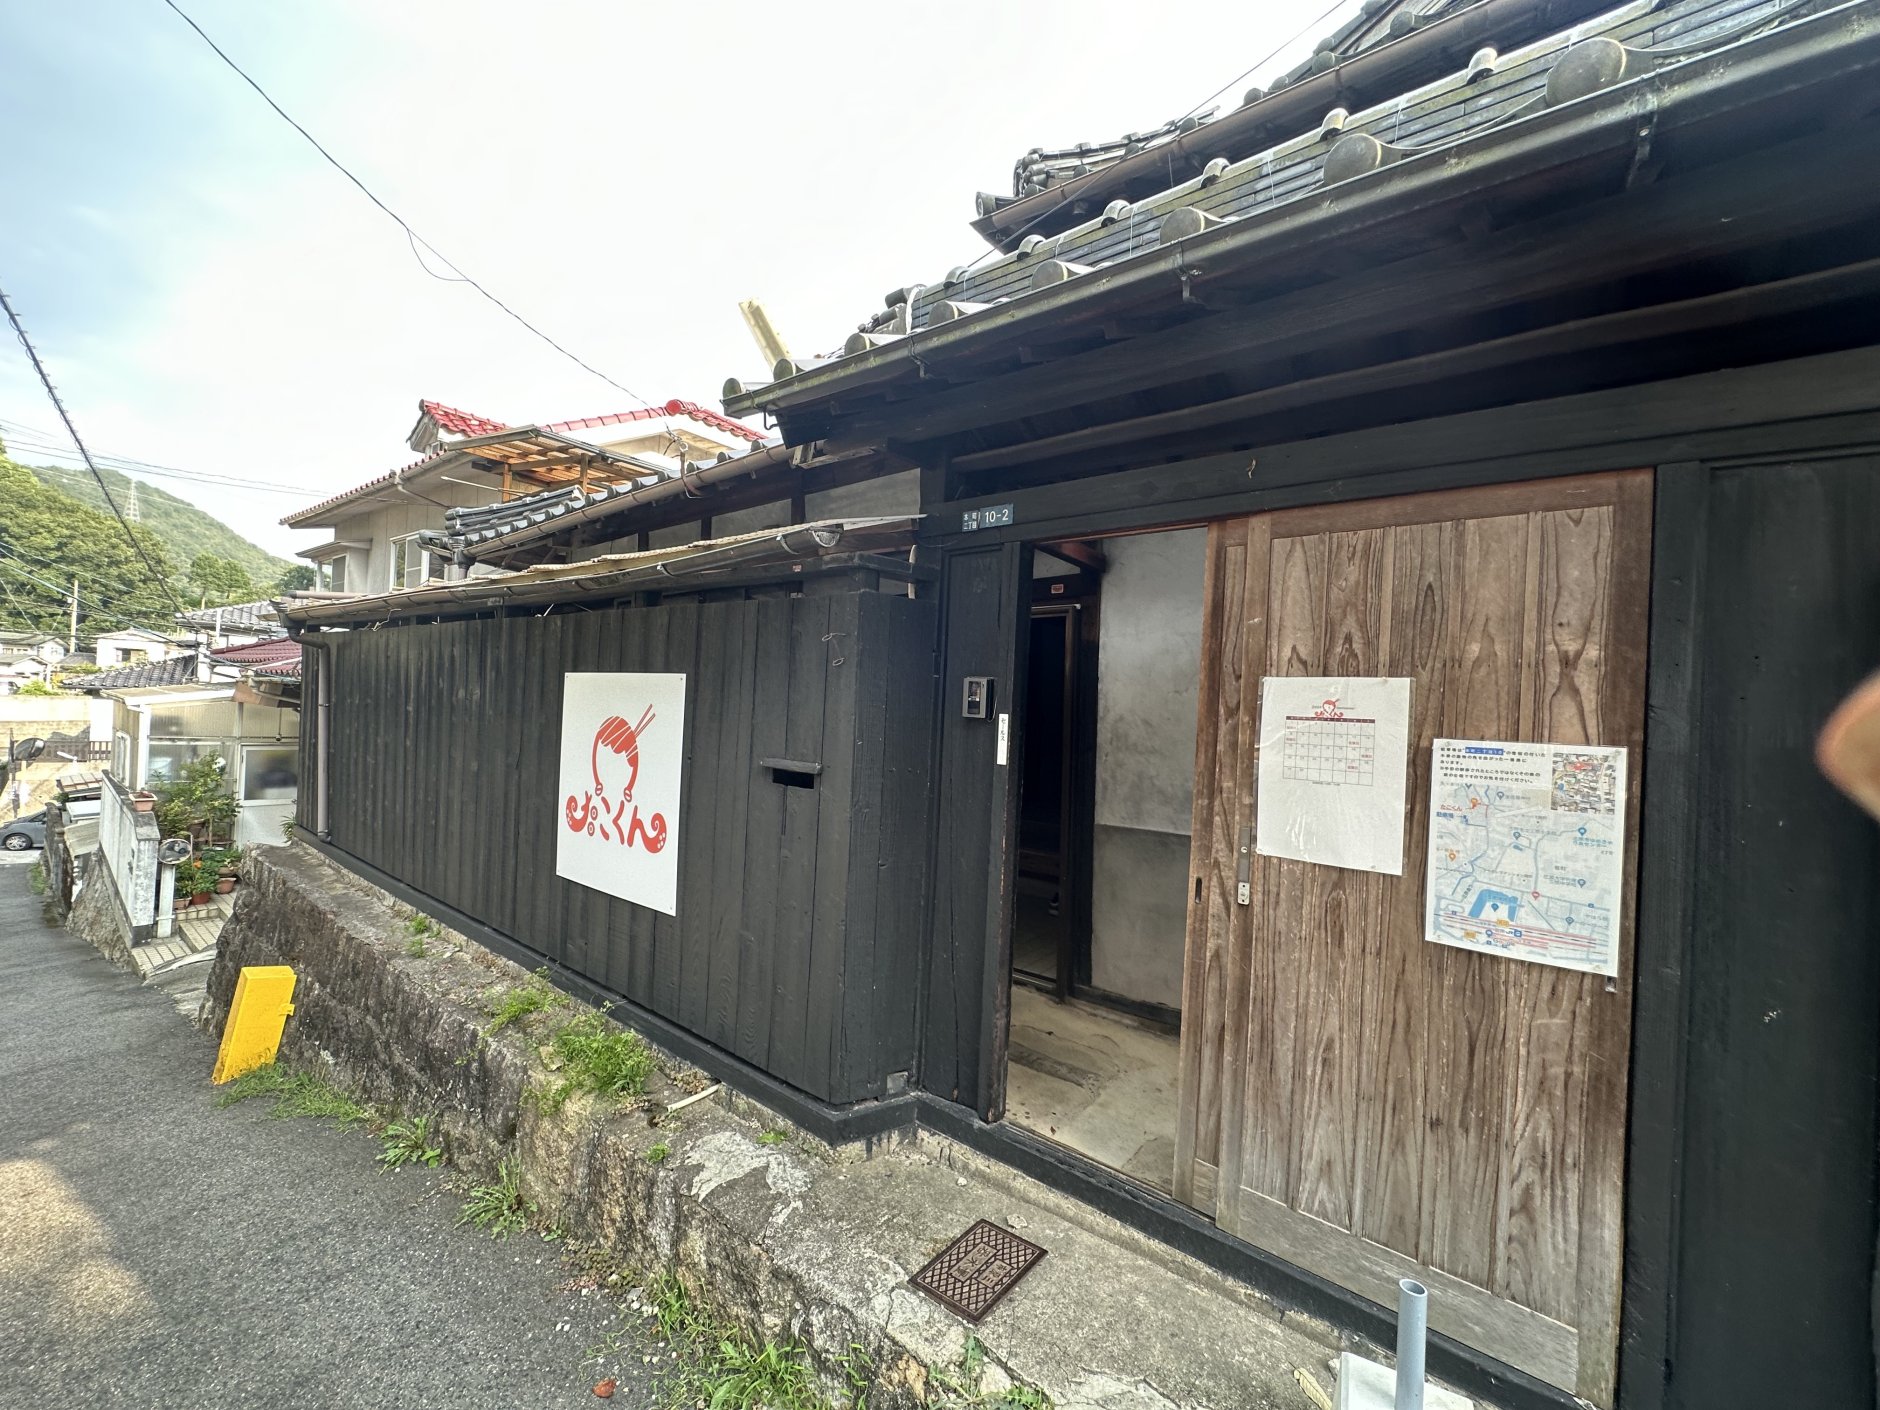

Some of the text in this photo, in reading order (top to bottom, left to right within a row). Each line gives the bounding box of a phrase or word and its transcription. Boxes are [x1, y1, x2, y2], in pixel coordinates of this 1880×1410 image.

[985, 509, 1009, 523] 10-2
[963, 521, 977, 530] 二丁目
